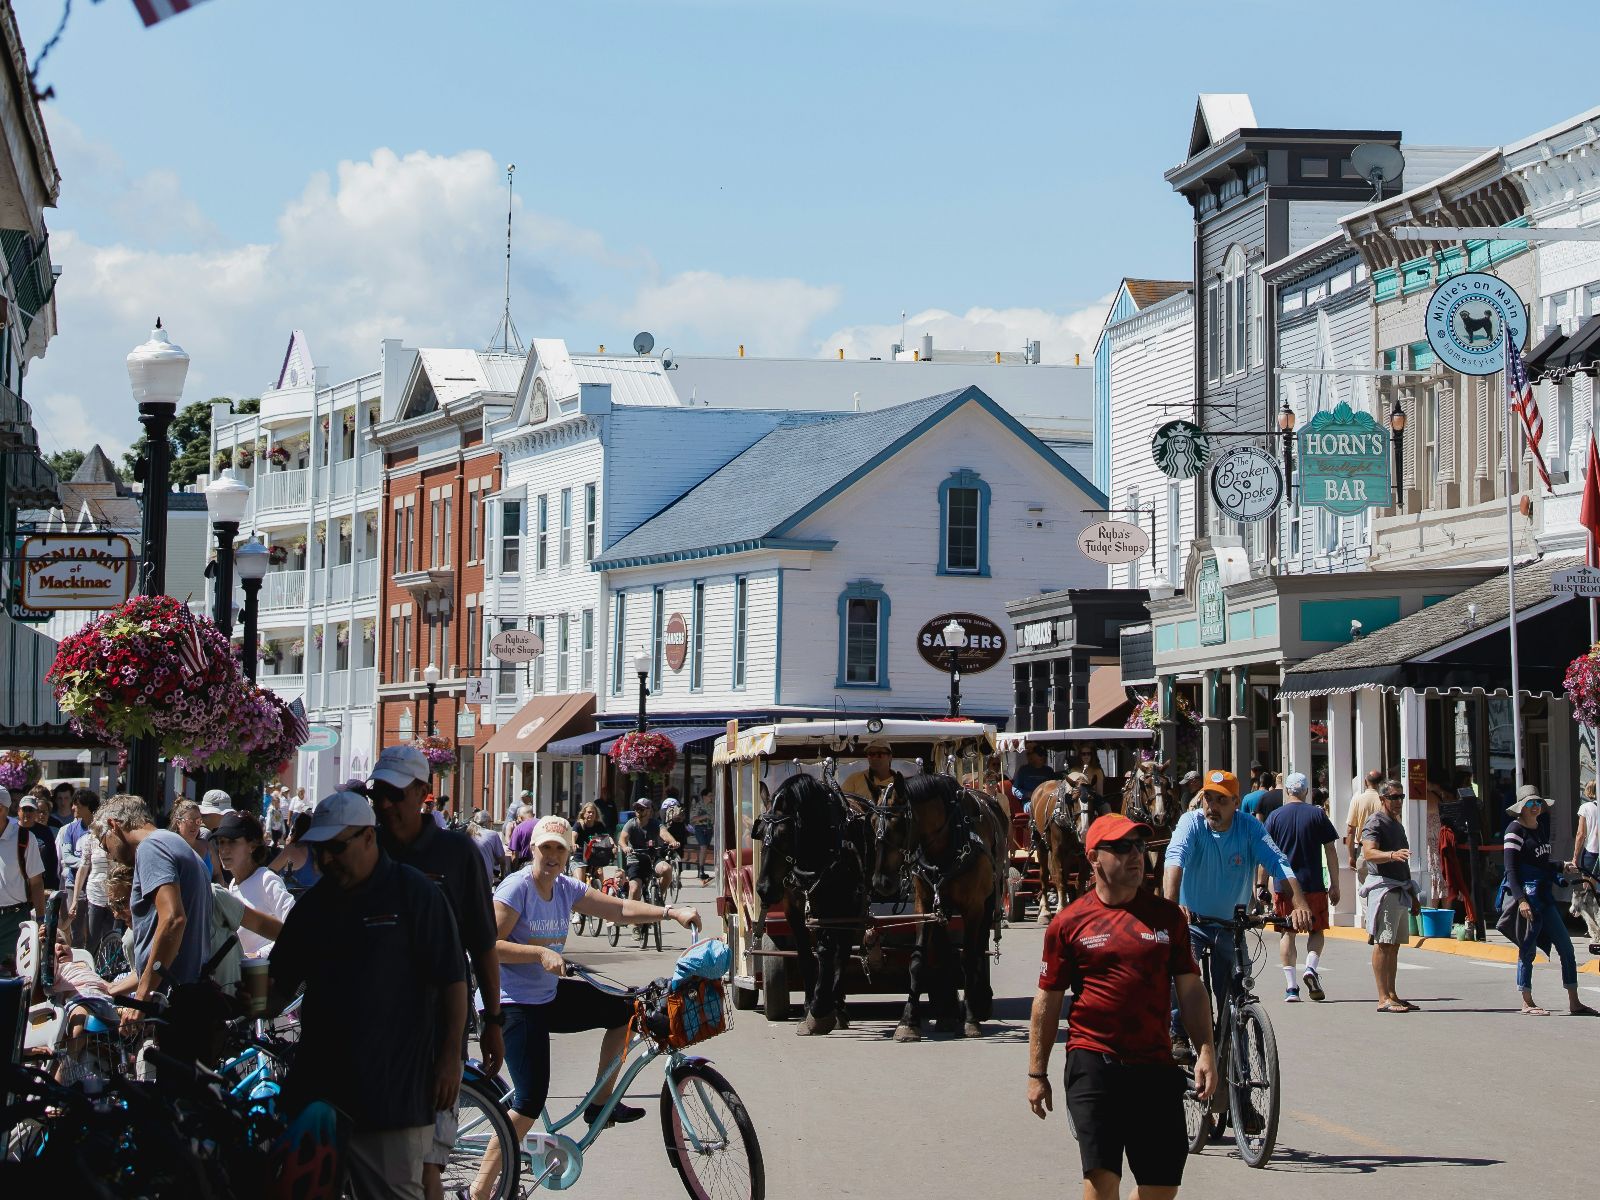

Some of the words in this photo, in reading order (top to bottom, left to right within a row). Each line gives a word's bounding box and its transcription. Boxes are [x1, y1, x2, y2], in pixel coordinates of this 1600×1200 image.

[1433, 282, 1468, 322] Millie's
[1473, 281, 1490, 291] on
[1494, 288, 1519, 319] Main
[1443, 342, 1496, 367] homestyle
[1306, 433, 1383, 455] HORN'S
[1234, 456, 1249, 467] The
[1218, 462, 1269, 488] Broken
[1226, 479, 1274, 512] Spoke
[1324, 479, 1368, 501] BAR
[1098, 525, 1131, 542] Ryba's
[1083, 539, 1112, 556] Fudge
[1114, 541, 1145, 556] Shops
[30, 547, 124, 575] BENJAMIN
[69, 564, 83, 573] of
[39, 575, 112, 590] Mackinac
[1566, 575, 1600, 583] PUBLIC
[1553, 584, 1600, 592] RESTROO
[505, 633, 530, 647] Ryba's
[922, 633, 1003, 649] SADERS
[494, 643, 517, 656] Fudge
[517, 645, 541, 657] Shops
